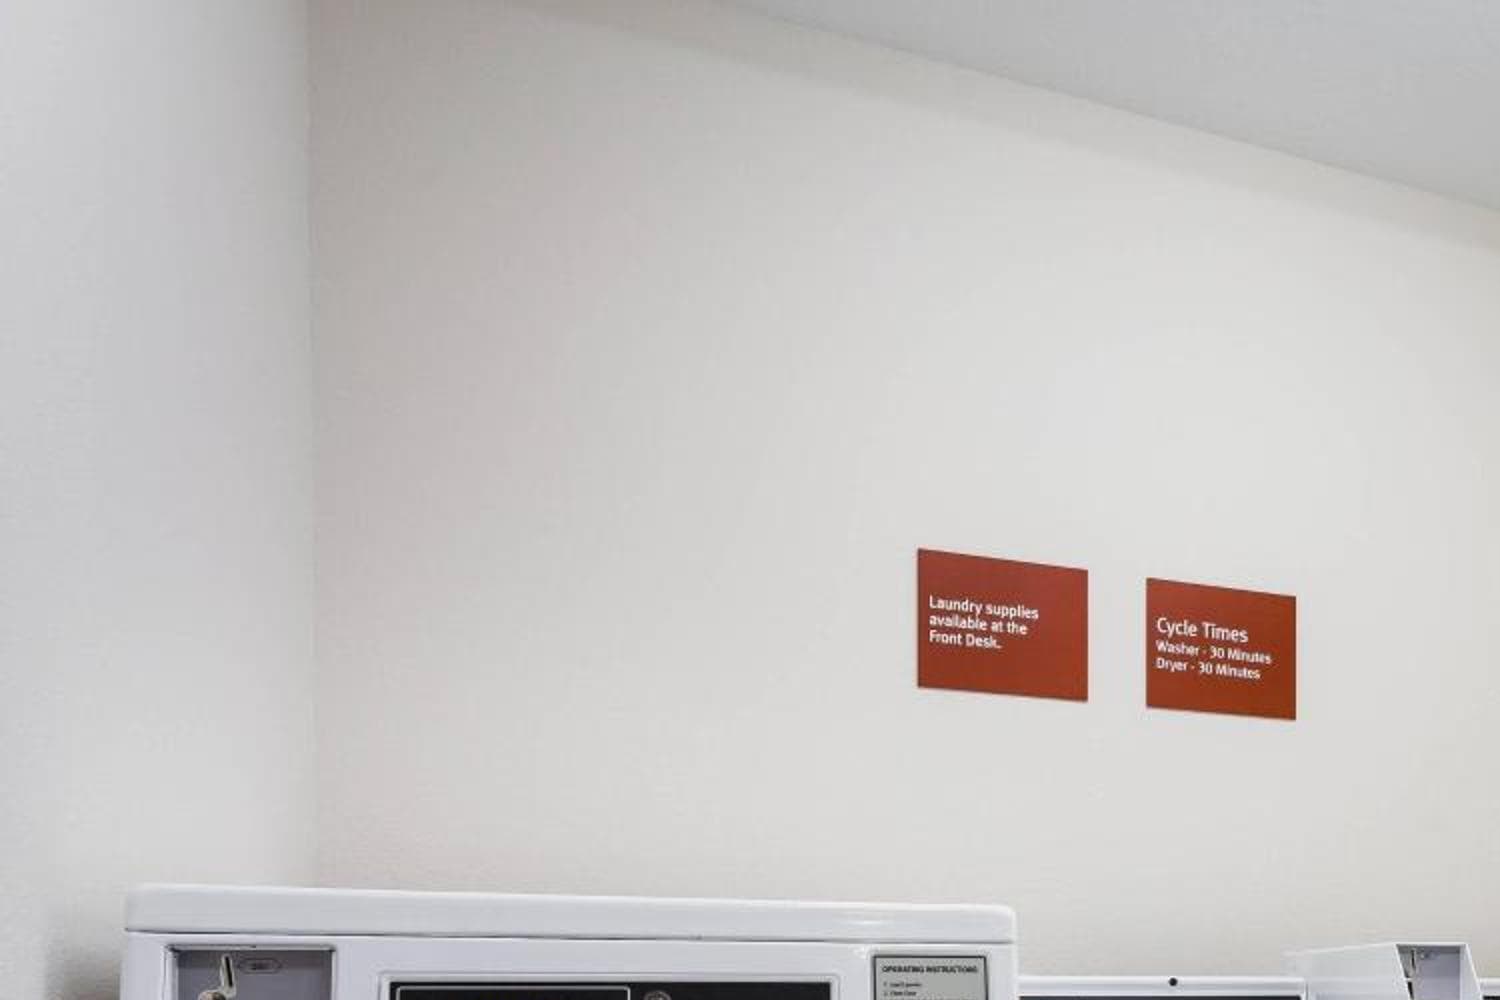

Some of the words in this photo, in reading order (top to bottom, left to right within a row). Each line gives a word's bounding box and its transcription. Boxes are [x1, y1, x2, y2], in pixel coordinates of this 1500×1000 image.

[929, 595, 982, 617] Laundry
[985, 603, 1039, 619] supplies
[929, 614, 987, 630] available
[991, 621, 1003, 632] at
[1008, 621, 1028, 635] the
[1157, 617, 1197, 638] Cycle
[1201, 621, 1249, 643] Times
[929, 629, 962, 644] Front
[966, 633, 1002, 649] Desk.
[1156, 640, 1200, 656] Washer
[1209, 646, 1224, 659] 30
[1227, 647, 1272, 664] Minutes
[1156, 658, 1188, 672] Dryer
[1199, 662, 1213, 674] 30
[1215, 663, 1260, 679] Minutes
